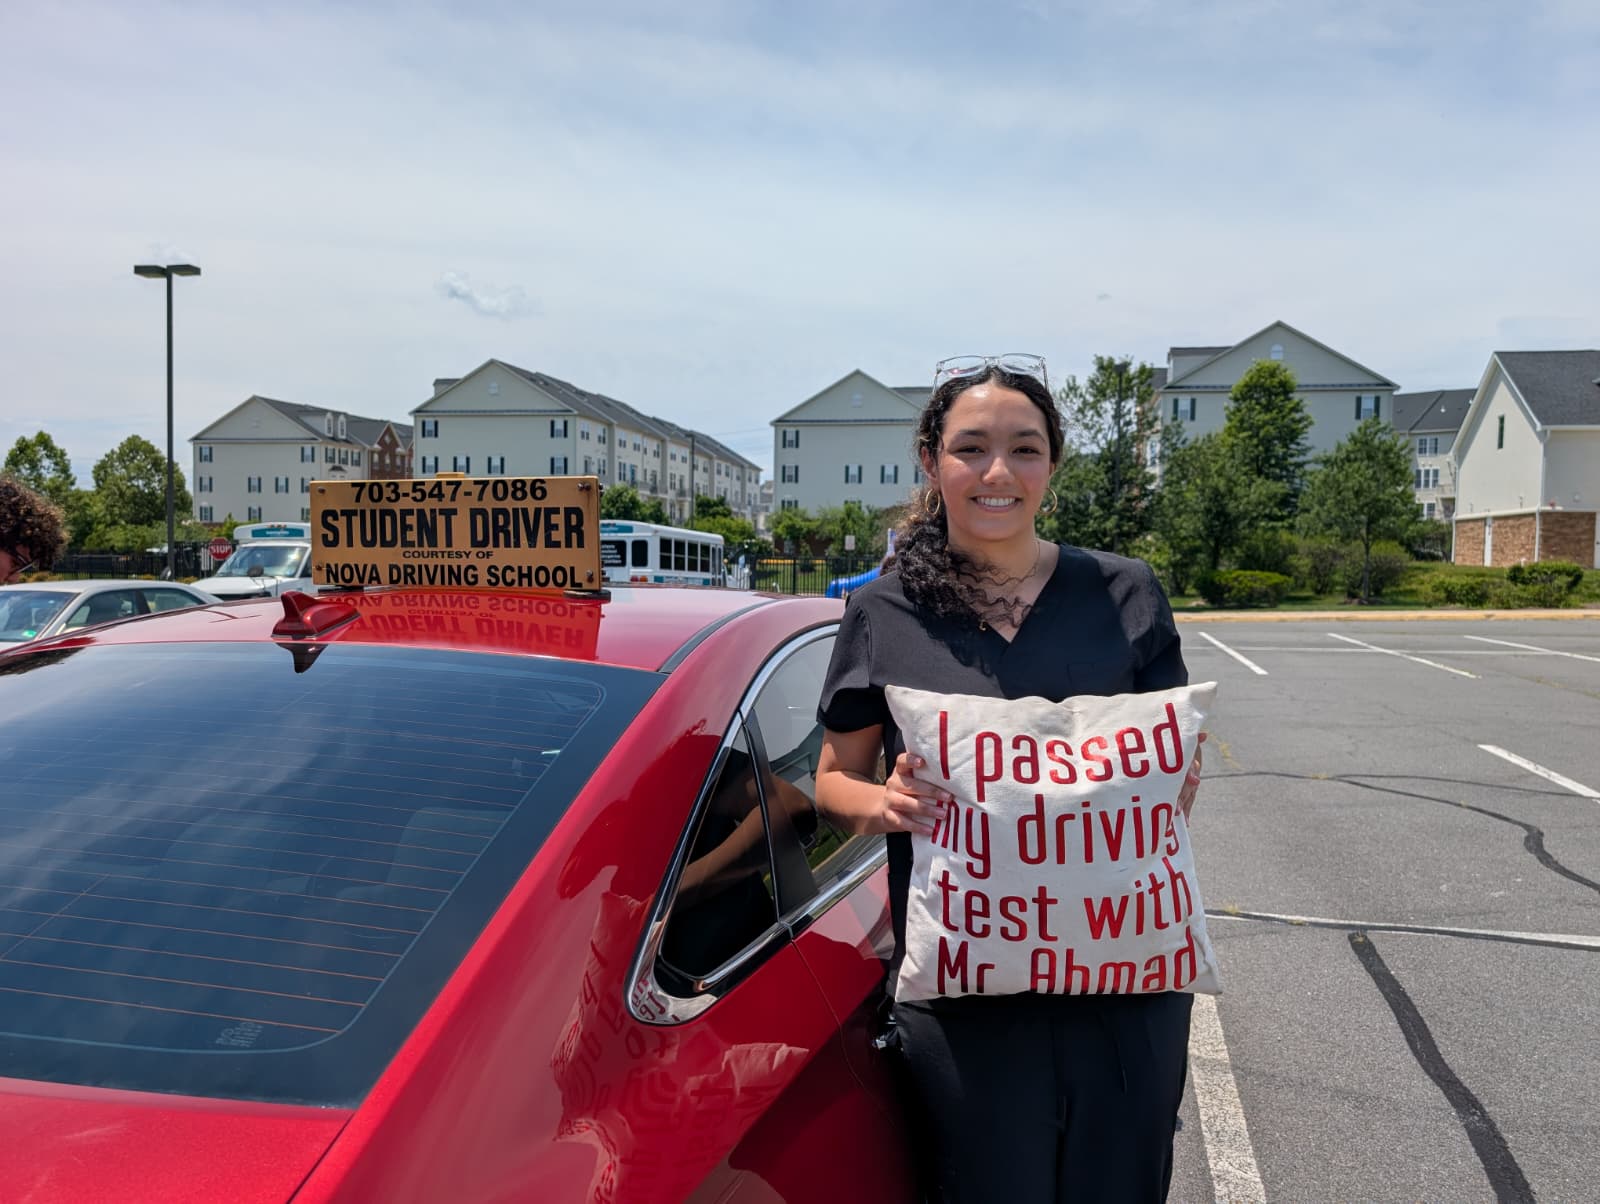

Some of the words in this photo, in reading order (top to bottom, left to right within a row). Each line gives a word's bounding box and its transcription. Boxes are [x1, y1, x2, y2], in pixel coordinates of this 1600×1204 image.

[351, 479, 547, 503] 703-547-7086
[321, 508, 457, 548] STUDENT
[469, 507, 584, 548] DRIVER
[210, 545, 230, 554] STOP
[402, 550, 472, 559] COURTESY
[476, 550, 494, 559] OF
[326, 563, 381, 585] NOVA
[388, 564, 478, 586] DRIVING
[486, 564, 583, 588] SCHOOL
[939, 711, 950, 780] I
[975, 703, 1184, 803] passed
[931, 799, 991, 879] my
[937, 870, 1058, 942] test
[1084, 856, 1193, 940] with
[937, 936, 995, 995] Mr
[1030, 925, 1198, 995] Ahmad
